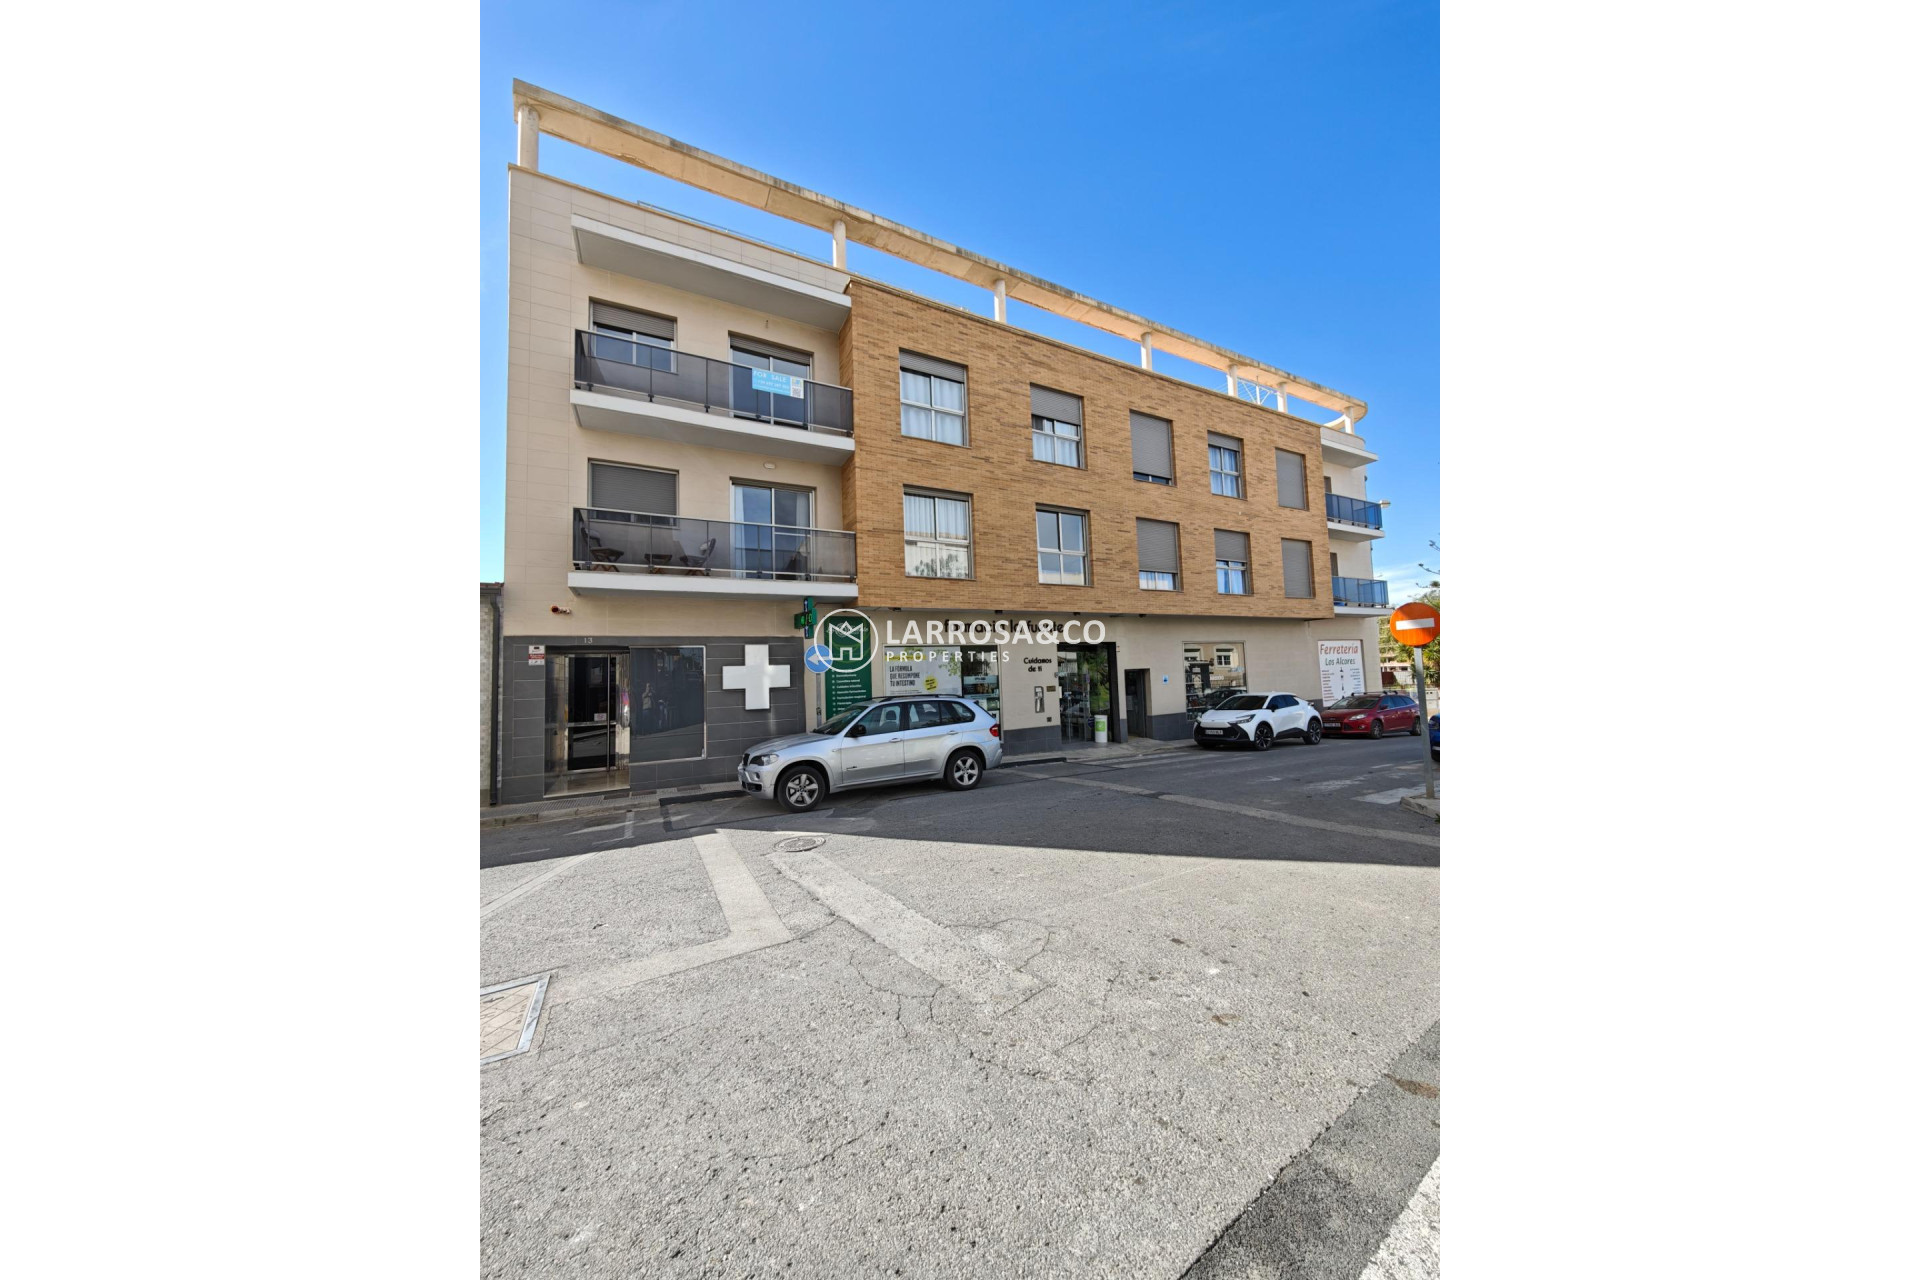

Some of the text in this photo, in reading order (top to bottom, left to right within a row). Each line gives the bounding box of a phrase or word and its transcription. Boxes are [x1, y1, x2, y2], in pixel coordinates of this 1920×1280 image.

[753, 370, 787, 382] FOR SALE
[944, 618, 1007, 633] famacia
[1027, 619, 1064, 633] fute
[1023, 657, 1052, 665] Cuidamos
